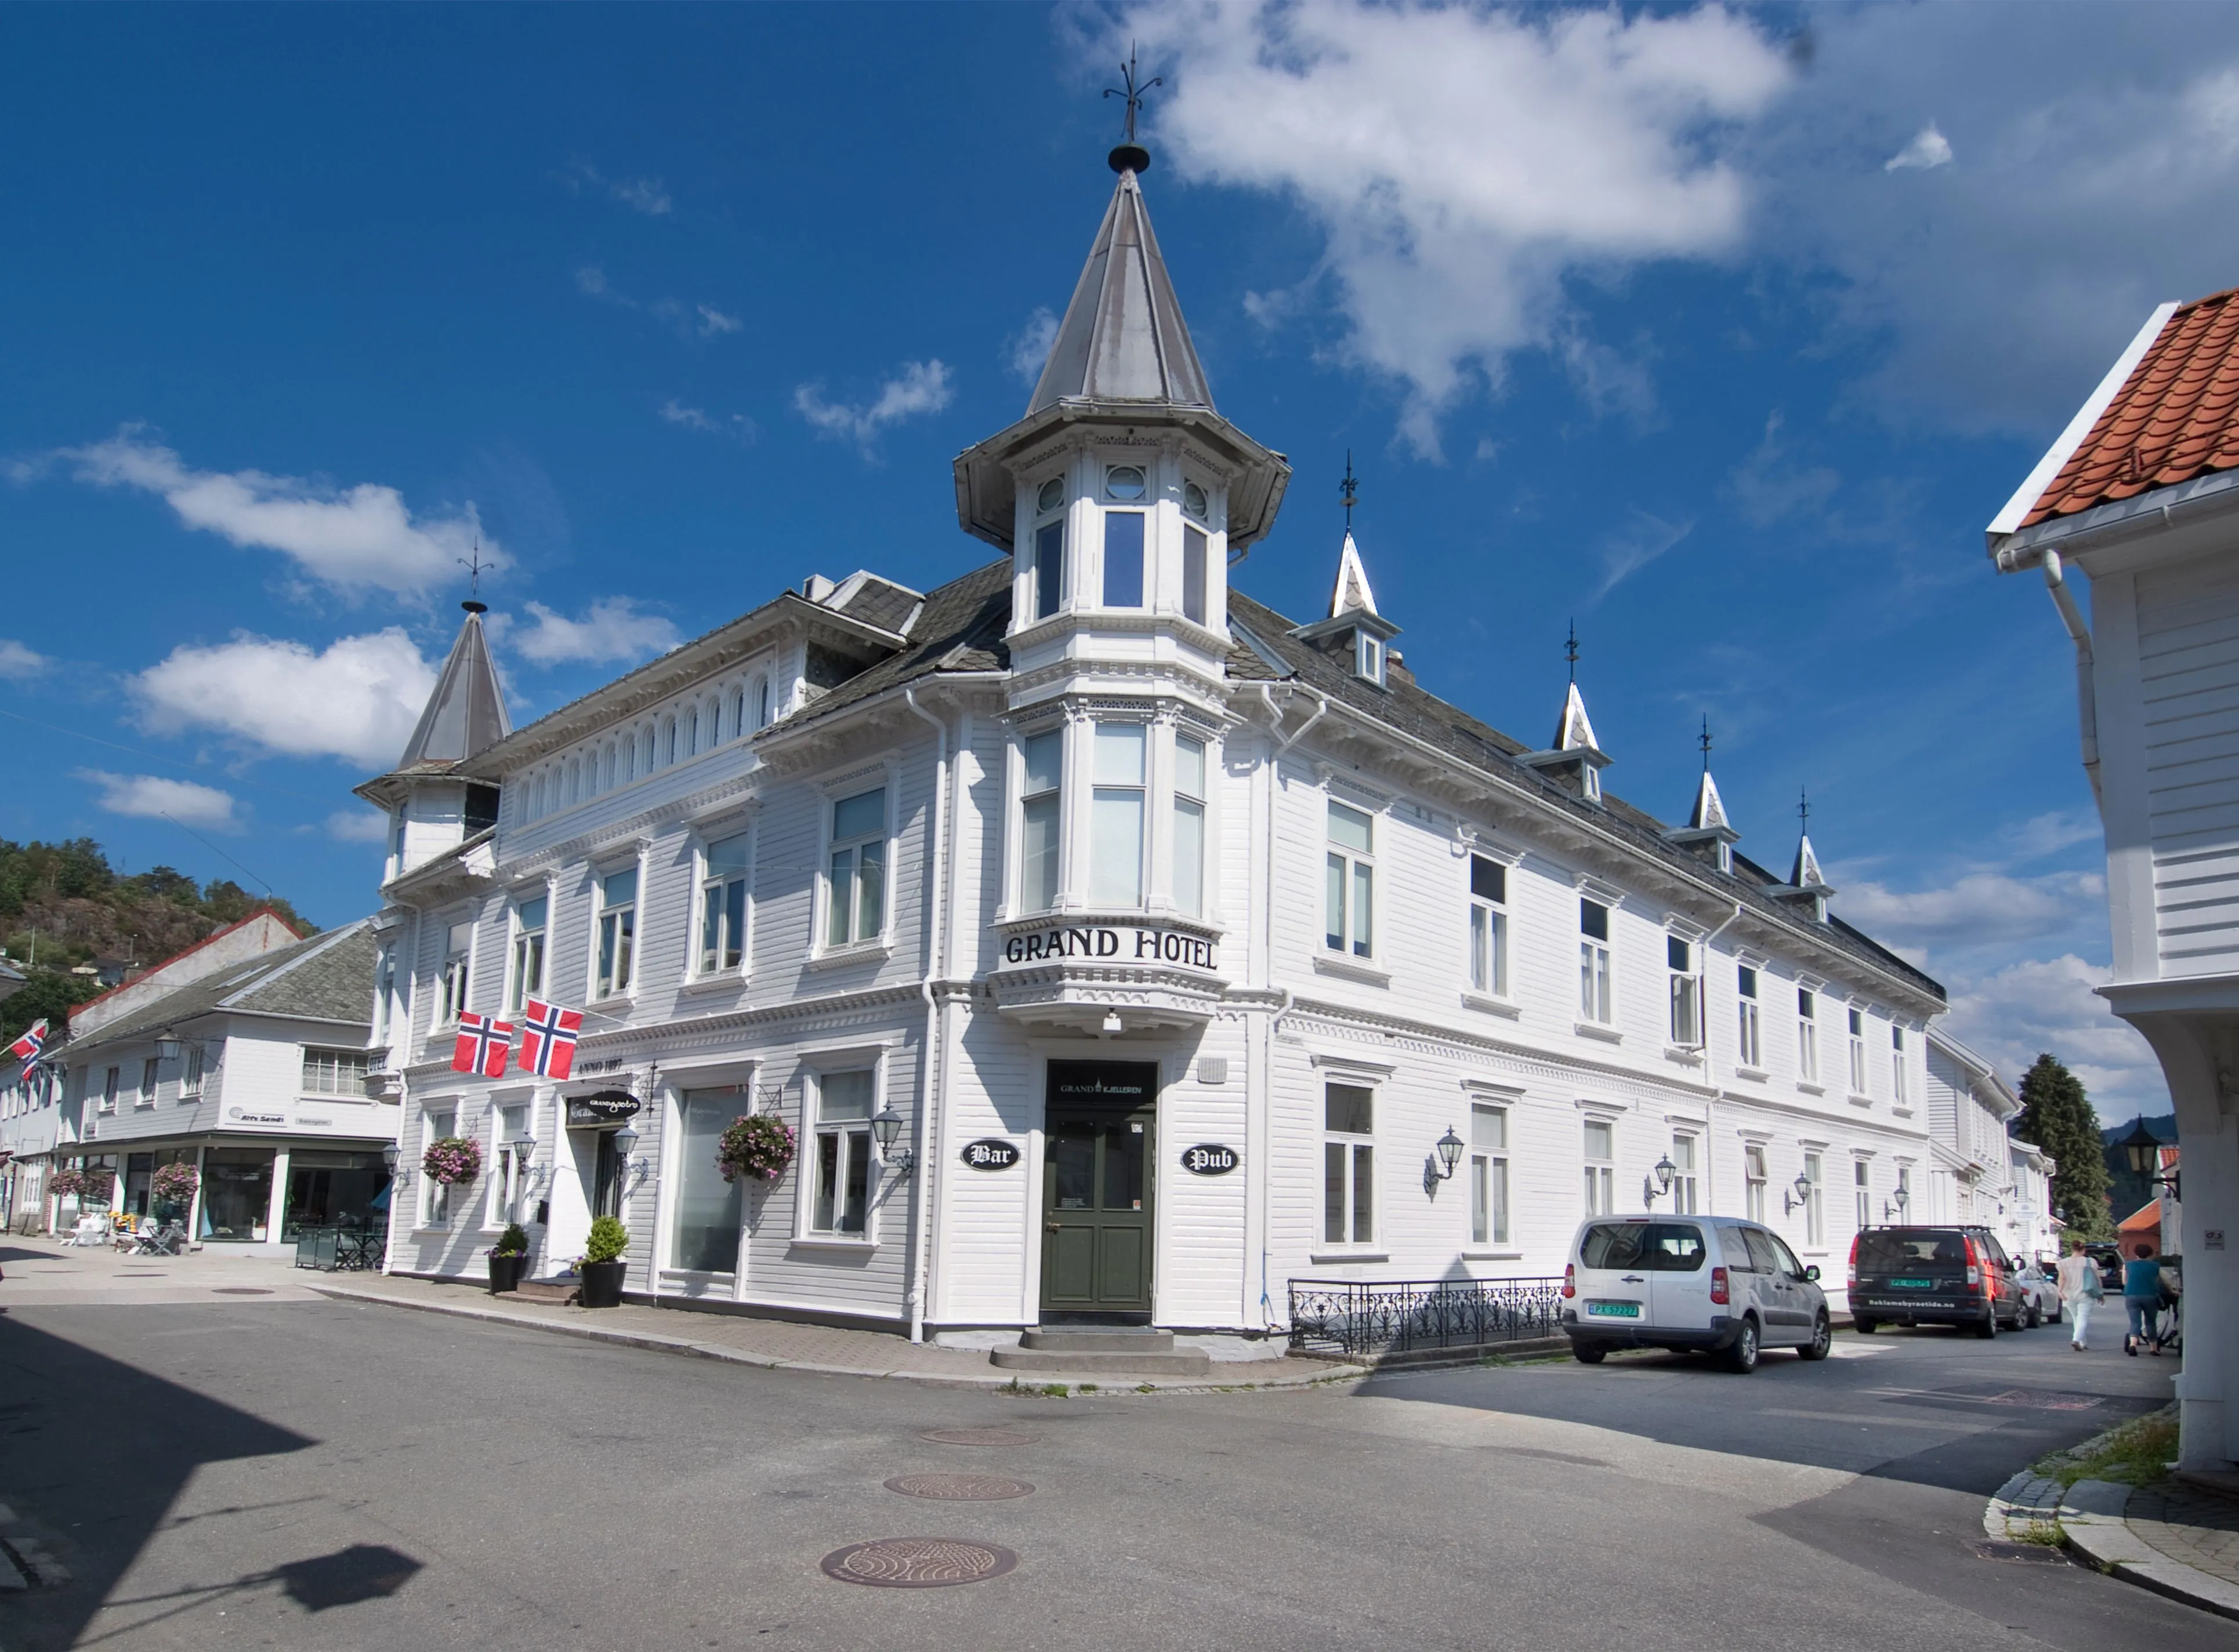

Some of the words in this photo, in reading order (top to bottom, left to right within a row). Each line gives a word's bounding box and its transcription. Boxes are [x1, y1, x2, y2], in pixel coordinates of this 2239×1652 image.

[1006, 929, 1119, 963] GRAND
[1135, 930, 1218, 970] HOTEL
[578, 1061, 603, 1075] ANNO
[1060, 1085, 1094, 1093] GRAND
[970, 1144, 1011, 1165] Bar
[1189, 1149, 1231, 1170] Pub
[1596, 1306, 1606, 1314] PX
[1610, 1306, 1636, 1314] 57227
